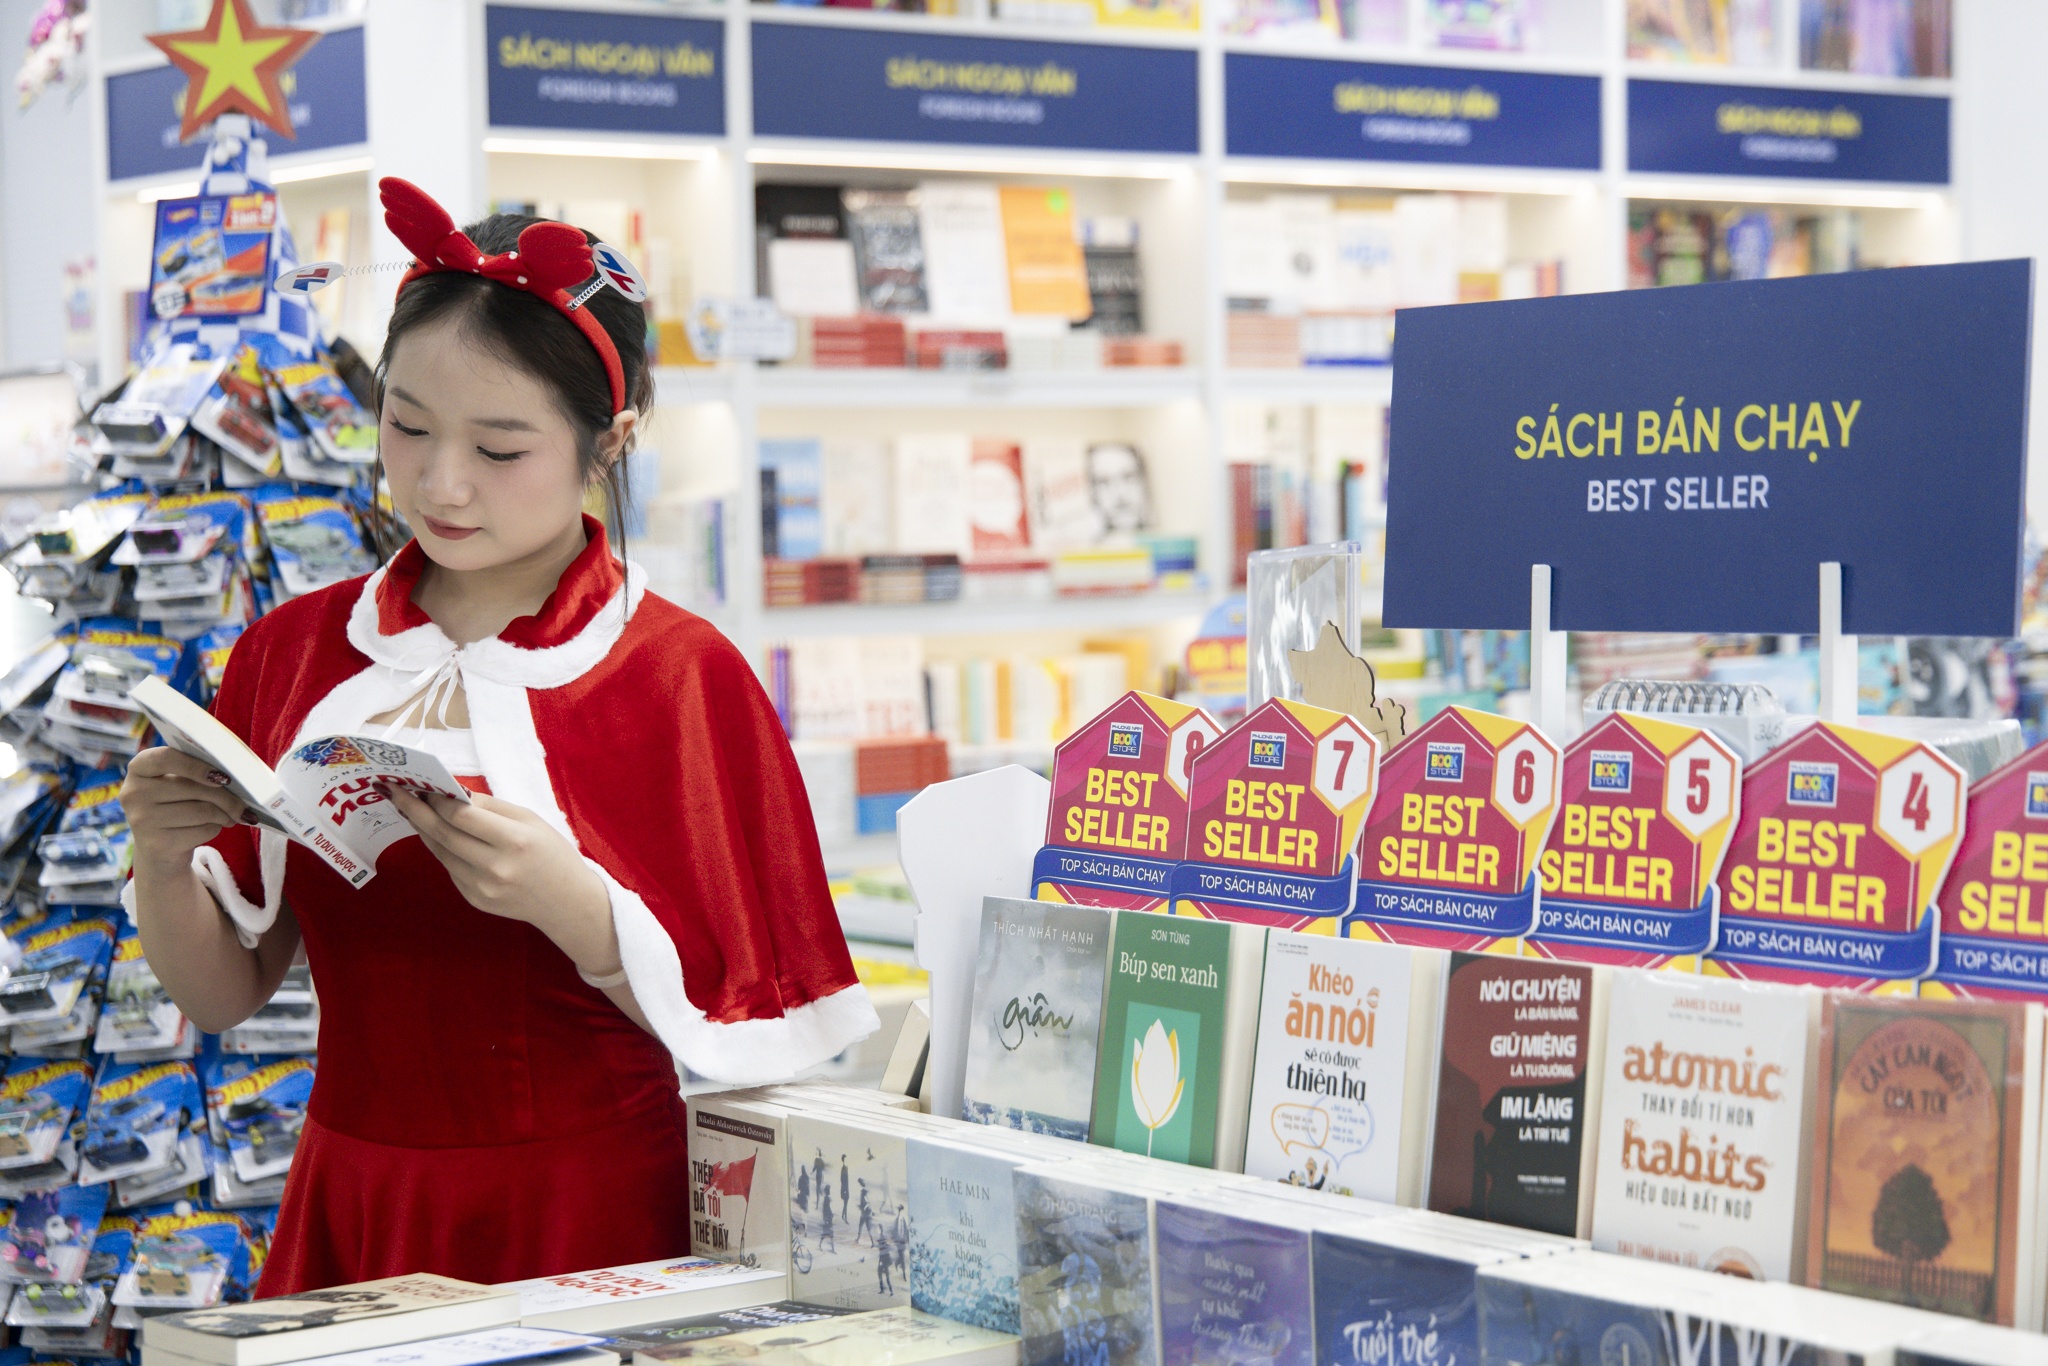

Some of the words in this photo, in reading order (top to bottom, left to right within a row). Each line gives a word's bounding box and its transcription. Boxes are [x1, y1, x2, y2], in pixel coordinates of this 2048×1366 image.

[499, 32, 572, 69] SÁCH
[1514, 403, 1623, 460] SÁCH
[1636, 397, 1721, 455] BÁN
[1734, 400, 1862, 463] CHẠY
[1587, 478, 1656, 512] BEST
[1664, 474, 1769, 511] SELLER
[1113, 733, 1138, 745] BOOK
[1113, 745, 1137, 753] STORE
[1254, 742, 1281, 756] BOOK
[1254, 755, 1280, 764] STORE
[1333, 740, 1354, 791] 7
[1431, 754, 1459, 768] BOOK
[1431, 768, 1458, 776] STORE
[1595, 762, 1626, 777] BOOK
[321, 766, 373, 790] JONAH
[1086, 767, 1158, 807] BEST
[1512, 750, 1535, 804] 6
[1686, 758, 1710, 815] 5
[1794, 774, 1831, 791] BOOK
[1225, 779, 1305, 822] BEST
[1402, 793, 1485, 837] BEST
[1902, 772, 1930, 832] 4
[1065, 806, 1170, 852] SELLER
[1564, 804, 1656, 851] BEST
[1757, 817, 1866, 868] BEST
[320, 840, 338, 856] DUY
[1203, 819, 1319, 869] SELLER
[1060, 858, 1082, 872] TOP
[1082, 858, 1110, 876] SÁCH
[1112, 861, 1136, 879] BÁN
[1137, 866, 1166, 884] CHẠY
[1379, 836, 1500, 886] SELLER
[1540, 849, 1673, 902] SELLER
[1200, 875, 1222, 889] TOP
[1223, 875, 1256, 894] SÁCH
[1258, 879, 1285, 898] BÁN
[1286, 884, 1316, 901] CHẠY
[1729, 865, 1887, 924] SELLER
[1375, 893, 1399, 908] TOP
[1400, 894, 1433, 914] SÁCH
[1435, 898, 1462, 917] BÁN
[1463, 903, 1497, 922] CHẠY
[993, 921, 1025, 936] THÍCH
[1028, 926, 1058, 940] NHẤT
[1061, 930, 1094, 945] HẠNH
[1151, 929, 1168, 942] SƠN
[1540, 909, 1562, 927] TOP
[1563, 910, 1600, 931] SÁCH
[1602, 913, 1631, 934] BÁN
[1633, 919, 1672, 939] CHẠY
[1725, 928, 1756, 948] TOP
[1758, 928, 1801, 951] SÁCH
[1803, 935, 1837, 957] BÁN
[1839, 941, 1885, 964] CHẠY
[1119, 951, 1147, 982] Búp
[1150, 963, 1176, 982] sen
[1180, 964, 1218, 988] xanh
[1954, 949, 1988, 970] TOP
[1990, 949, 2037, 975] SÁCH
[1308, 963, 1354, 996] Khéo
[1479, 976, 1509, 1001] NÓI
[1511, 974, 1581, 1004] CHUYỆN
[1285, 991, 1324, 1041] ăn
[1328, 990, 1377, 1049] nói
[1672, 996, 1707, 1011] JAMES
[1708, 1000, 1742, 1016] CLEAR
[994, 992, 1074, 1051] giận
[1304, 1049, 1317, 1061] sẽ
[1319, 1051, 1331, 1064] có
[1333, 1050, 1361, 1070] được
[1490, 1031, 1521, 1057] GIỮ
[1522, 1031, 1577, 1061] MIỆNG
[1892, 1044, 1931, 1068] CAM
[1286, 1062, 1338, 1096] thiên
[1341, 1070, 1367, 1105] hạ
[1510, 1063, 1524, 1077] LÀ
[1525, 1063, 1537, 1077] TU
[1622, 1040, 1786, 1102] atomic
[698, 1114, 716, 1127] Nikolai
[1501, 1096, 1522, 1119] IM
[1523, 1093, 1573, 1123] LẶNG
[1642, 1092, 1675, 1115] THAY
[1708, 1102, 1722, 1123] TÍ
[1727, 1106, 1755, 1128] HON
[1519, 1127, 1533, 1141] LÀ
[1533, 1126, 1550, 1141] TRÍ
[1550, 1127, 1570, 1143] TUỆ
[1621, 1117, 1773, 1193] habits
[692, 1159, 714, 1185] THÉP
[693, 1187, 706, 1214] ĐÃ
[708, 1190, 721, 1218] TÔI
[1626, 1180, 1657, 1205] HIỆU
[1724, 1194, 1753, 1220] NGỜ
[959, 1210, 974, 1228] khi
[694, 1219, 711, 1244] THẾ
[712, 1222, 729, 1250] ĐẤY
[948, 1230, 966, 1244] mọi
[967, 1231, 987, 1249] điều
[955, 1244, 983, 1269] không
[957, 1263, 974, 1280] như
[614, 1278, 677, 1292] DUY
[1343, 1309, 1395, 1366] Tuổi
[1398, 1312, 1439, 1366] trẻ
